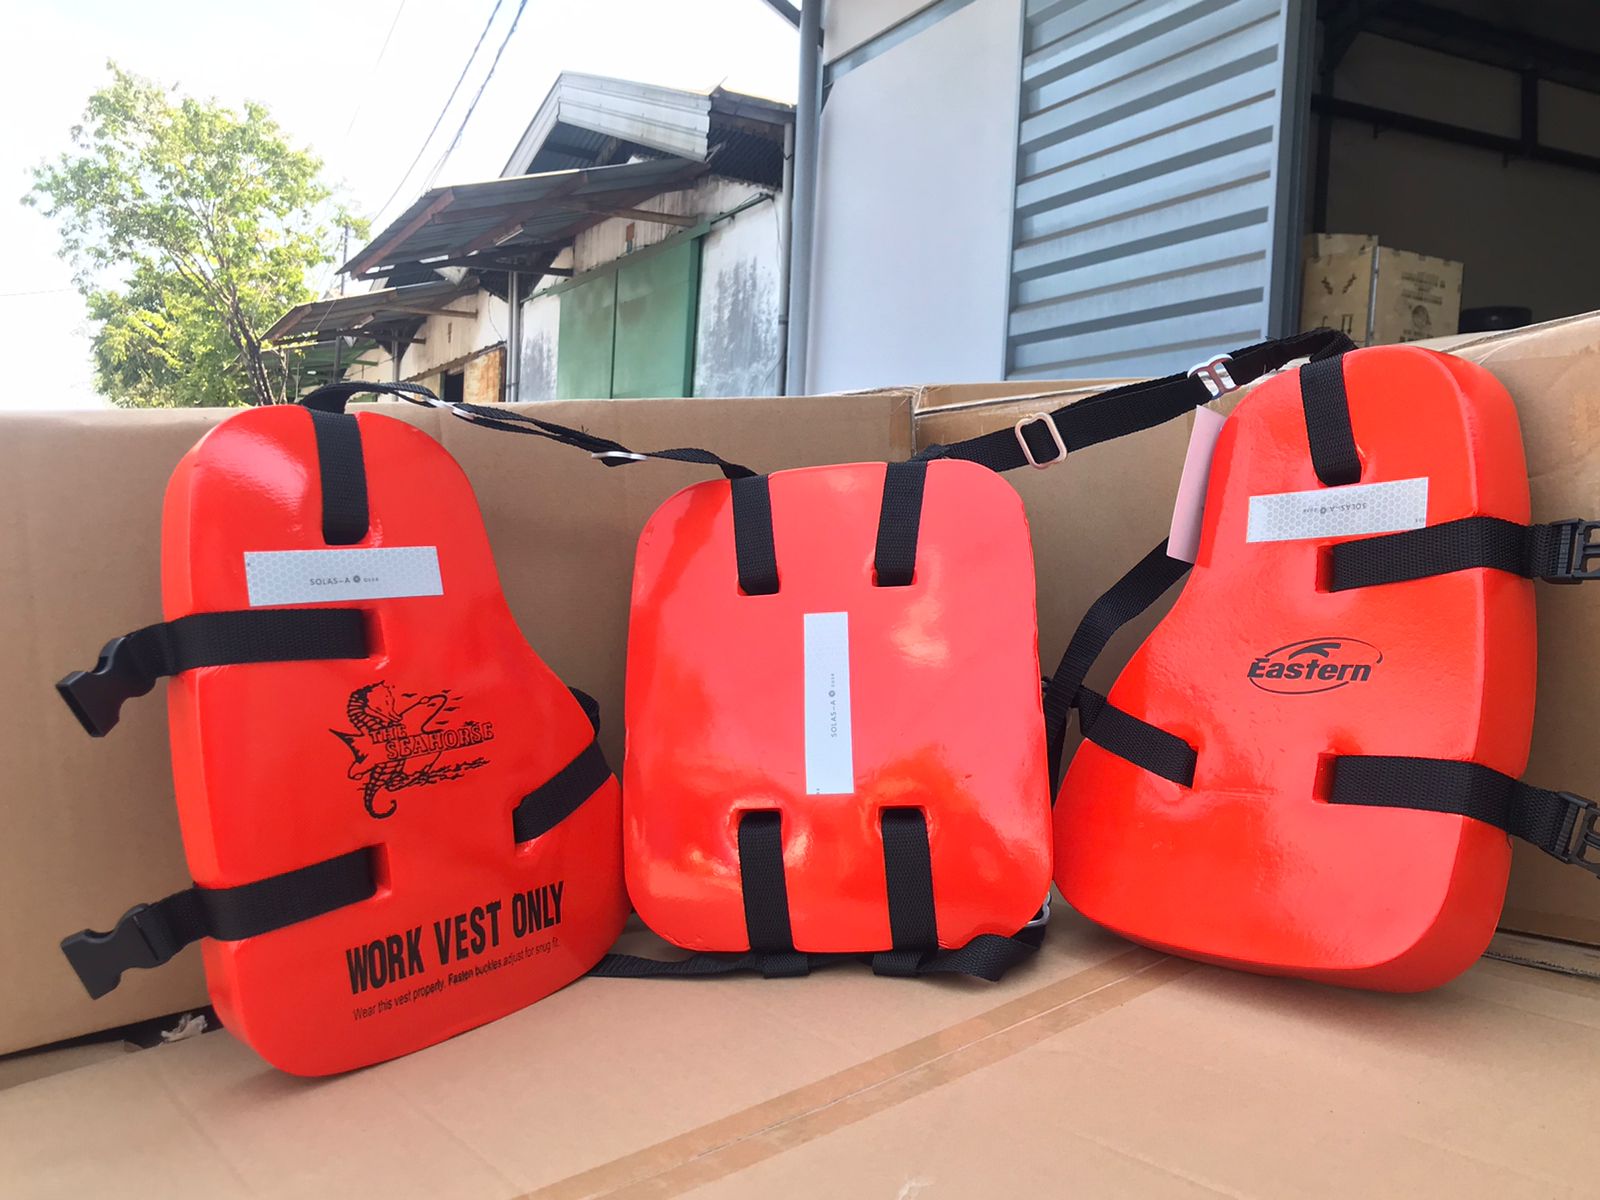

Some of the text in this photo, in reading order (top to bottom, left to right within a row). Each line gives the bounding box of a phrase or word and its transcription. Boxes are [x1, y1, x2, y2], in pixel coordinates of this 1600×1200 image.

[1329, 503, 1367, 513] SOLAS-A
[310, 577, 351, 586] SOLAS-A
[1247, 658, 1372, 682] Eastern
[369, 725, 408, 744] THE
[830, 700, 838, 738] SOLAS-A
[386, 721, 495, 760] SEAHORSE
[346, 880, 564, 995] WORK VEST ONLY
[353, 1004, 377, 1021] Wear
[378, 999, 393, 1014] this
[394, 991, 412, 1007] vest
[448, 967, 474, 986] Fasten
